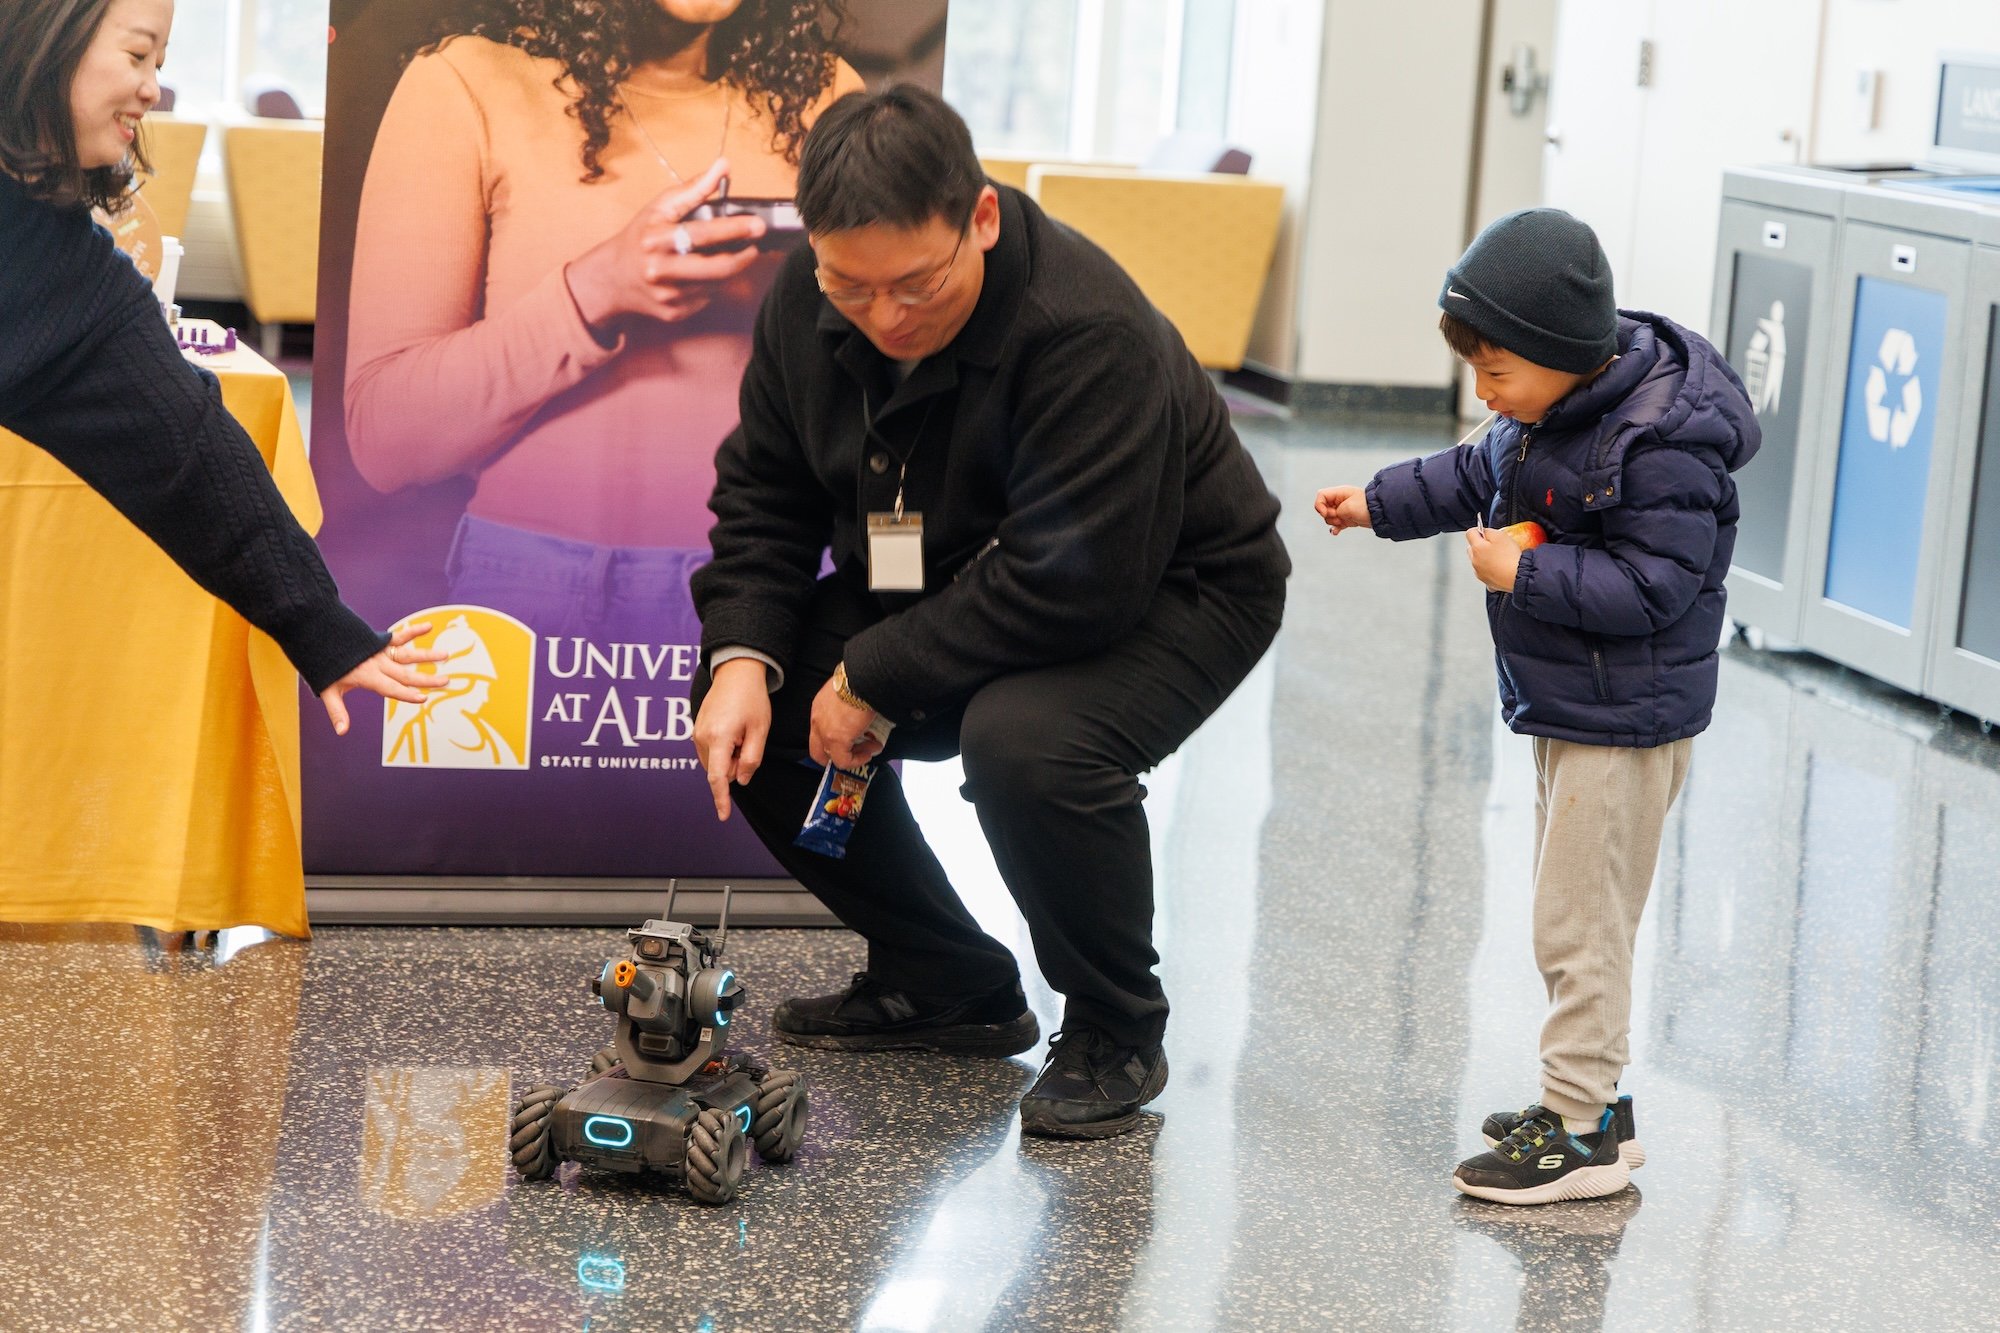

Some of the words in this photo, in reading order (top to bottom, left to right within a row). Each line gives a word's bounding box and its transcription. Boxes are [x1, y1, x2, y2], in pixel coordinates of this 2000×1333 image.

[545, 636, 702, 681] UNIVE
[542, 692, 590, 722] AT
[540, 755, 592, 768] STATE
[598, 756, 699, 770] UNIVERSITY
[1537, 1153, 1565, 1170] S
